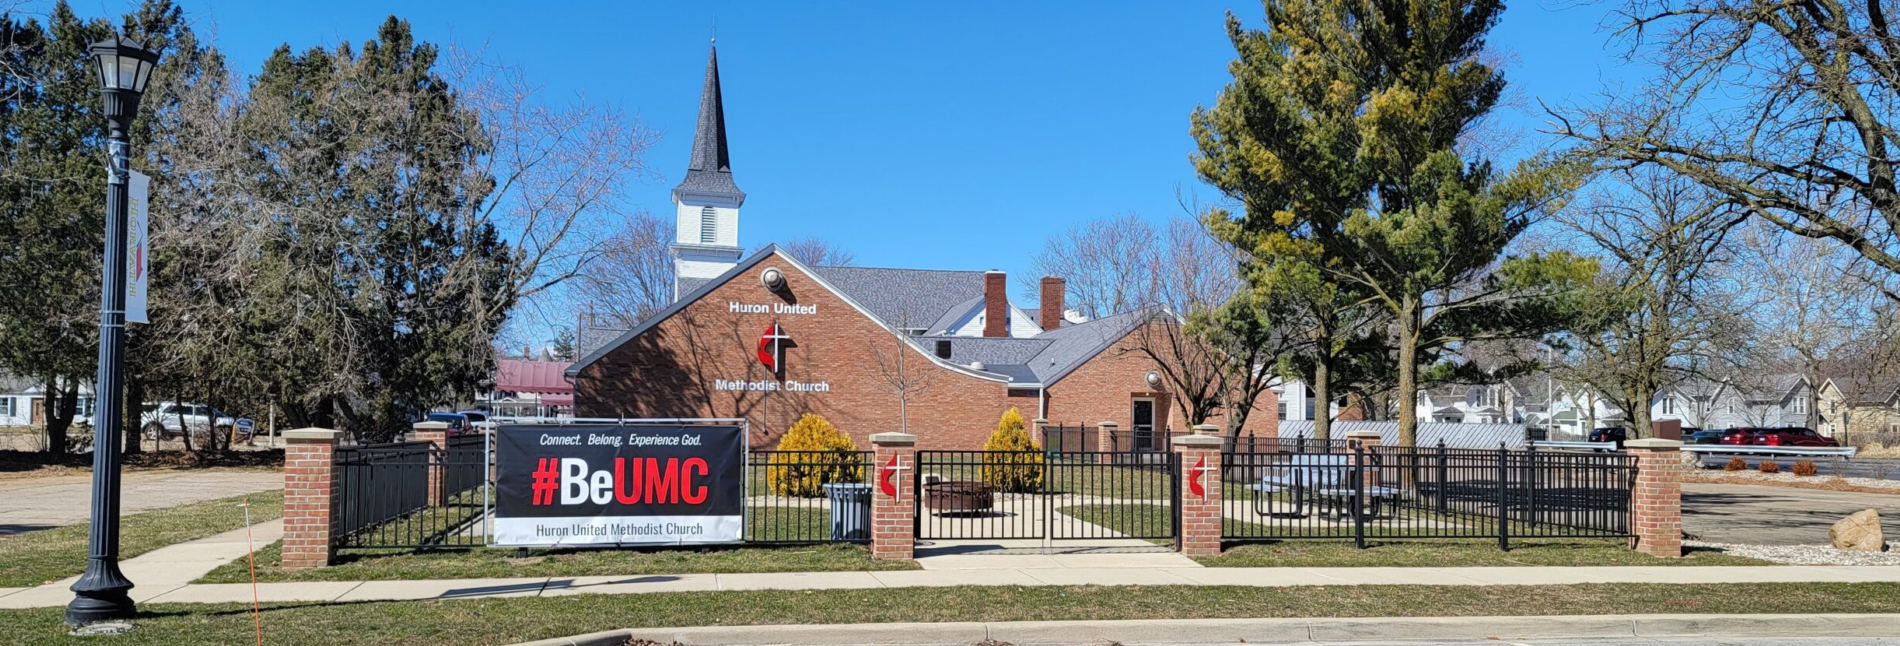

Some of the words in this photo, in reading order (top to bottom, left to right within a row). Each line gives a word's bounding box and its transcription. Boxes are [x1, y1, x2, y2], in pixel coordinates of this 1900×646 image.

[129, 198, 138, 297] HORVATH
[729, 301, 769, 313] Huron
[773, 303, 817, 315] United
[715, 379, 781, 391] Methodist
[785, 381, 829, 392] Church
[540, 433, 582, 446] Connect.
[587, 433, 623, 447] Belong.
[628, 433, 680, 447] Experience
[681, 434, 702, 446] God.
[531, 457, 709, 506] #BeUMC
[536, 525, 569, 537] Huron
[572, 524, 607, 536] United
[610, 523, 663, 536] Methodist
[666, 522, 703, 535] Church
